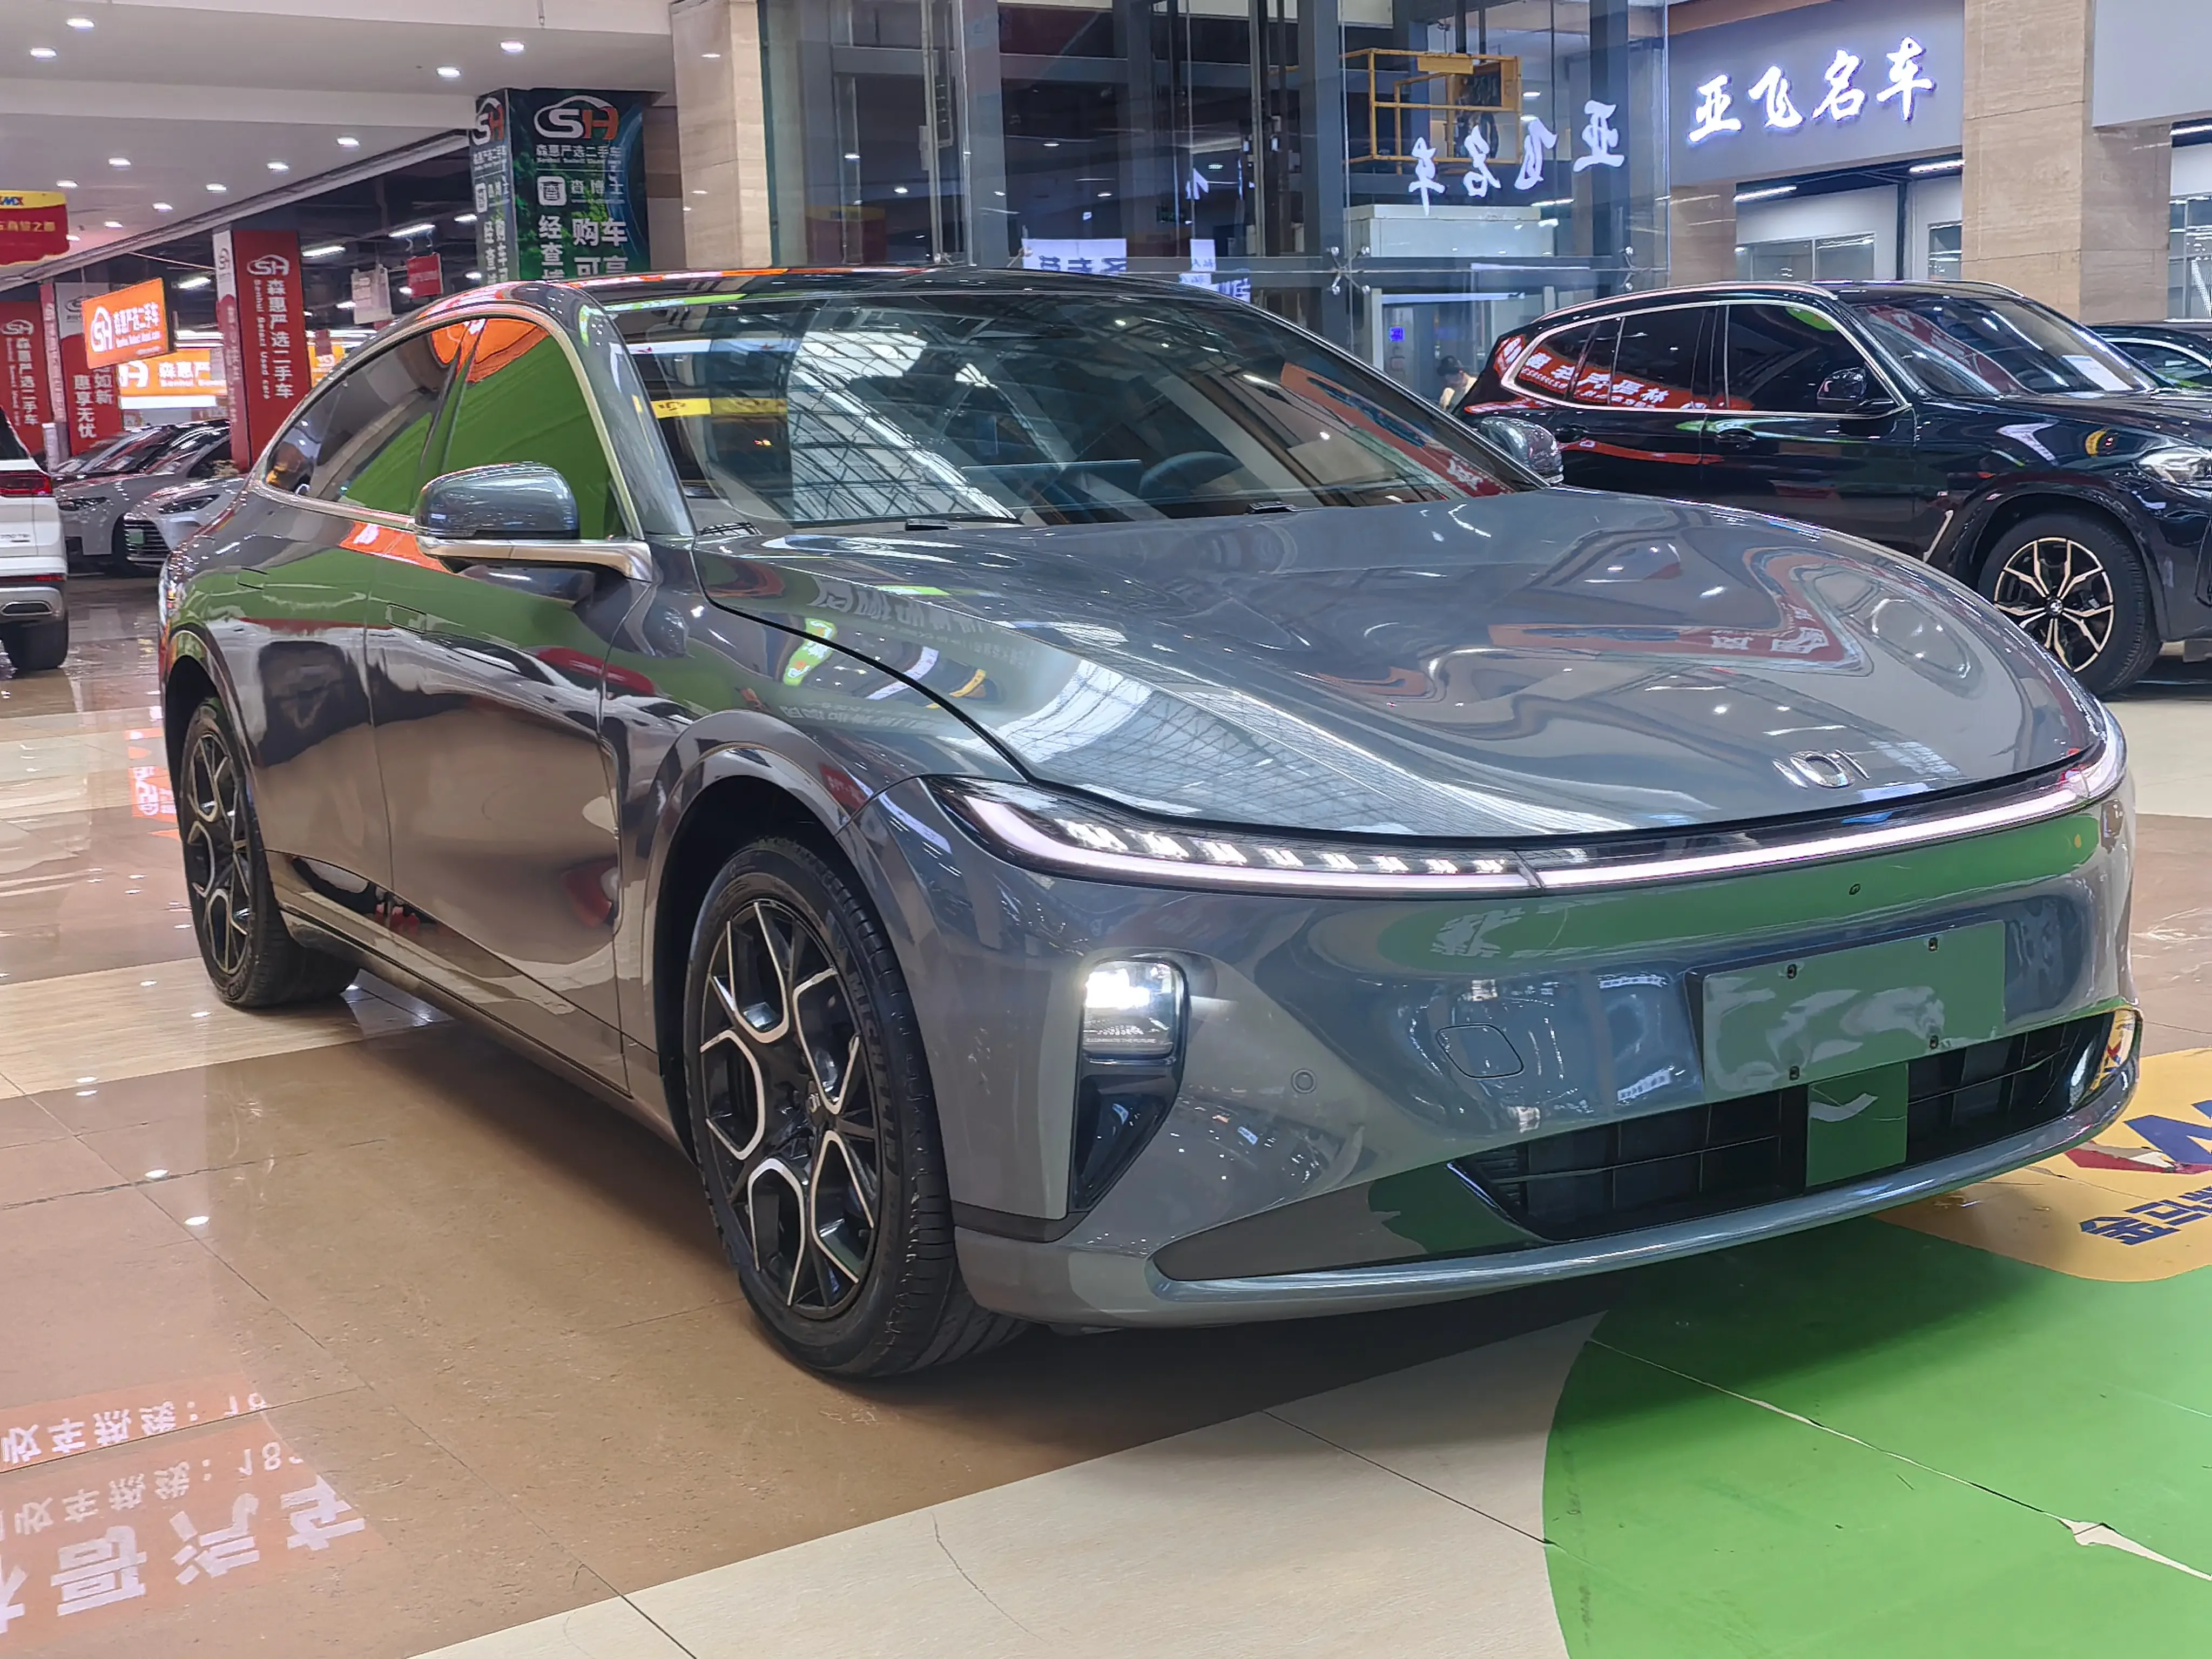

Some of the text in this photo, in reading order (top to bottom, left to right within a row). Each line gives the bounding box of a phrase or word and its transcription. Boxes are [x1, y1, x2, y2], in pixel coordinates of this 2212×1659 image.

[1687, 36, 1937, 143] 亚飞名车
[534, 95, 619, 140] SH
[571, 217, 628, 247] 购车
[246, 254, 290, 276] SH
[90, 305, 114, 353] SH
[267, 279, 295, 399] 森惠严选二手车
[93, 367, 113, 405] 如新
[847, 970, 897, 1163] MICHELIN
